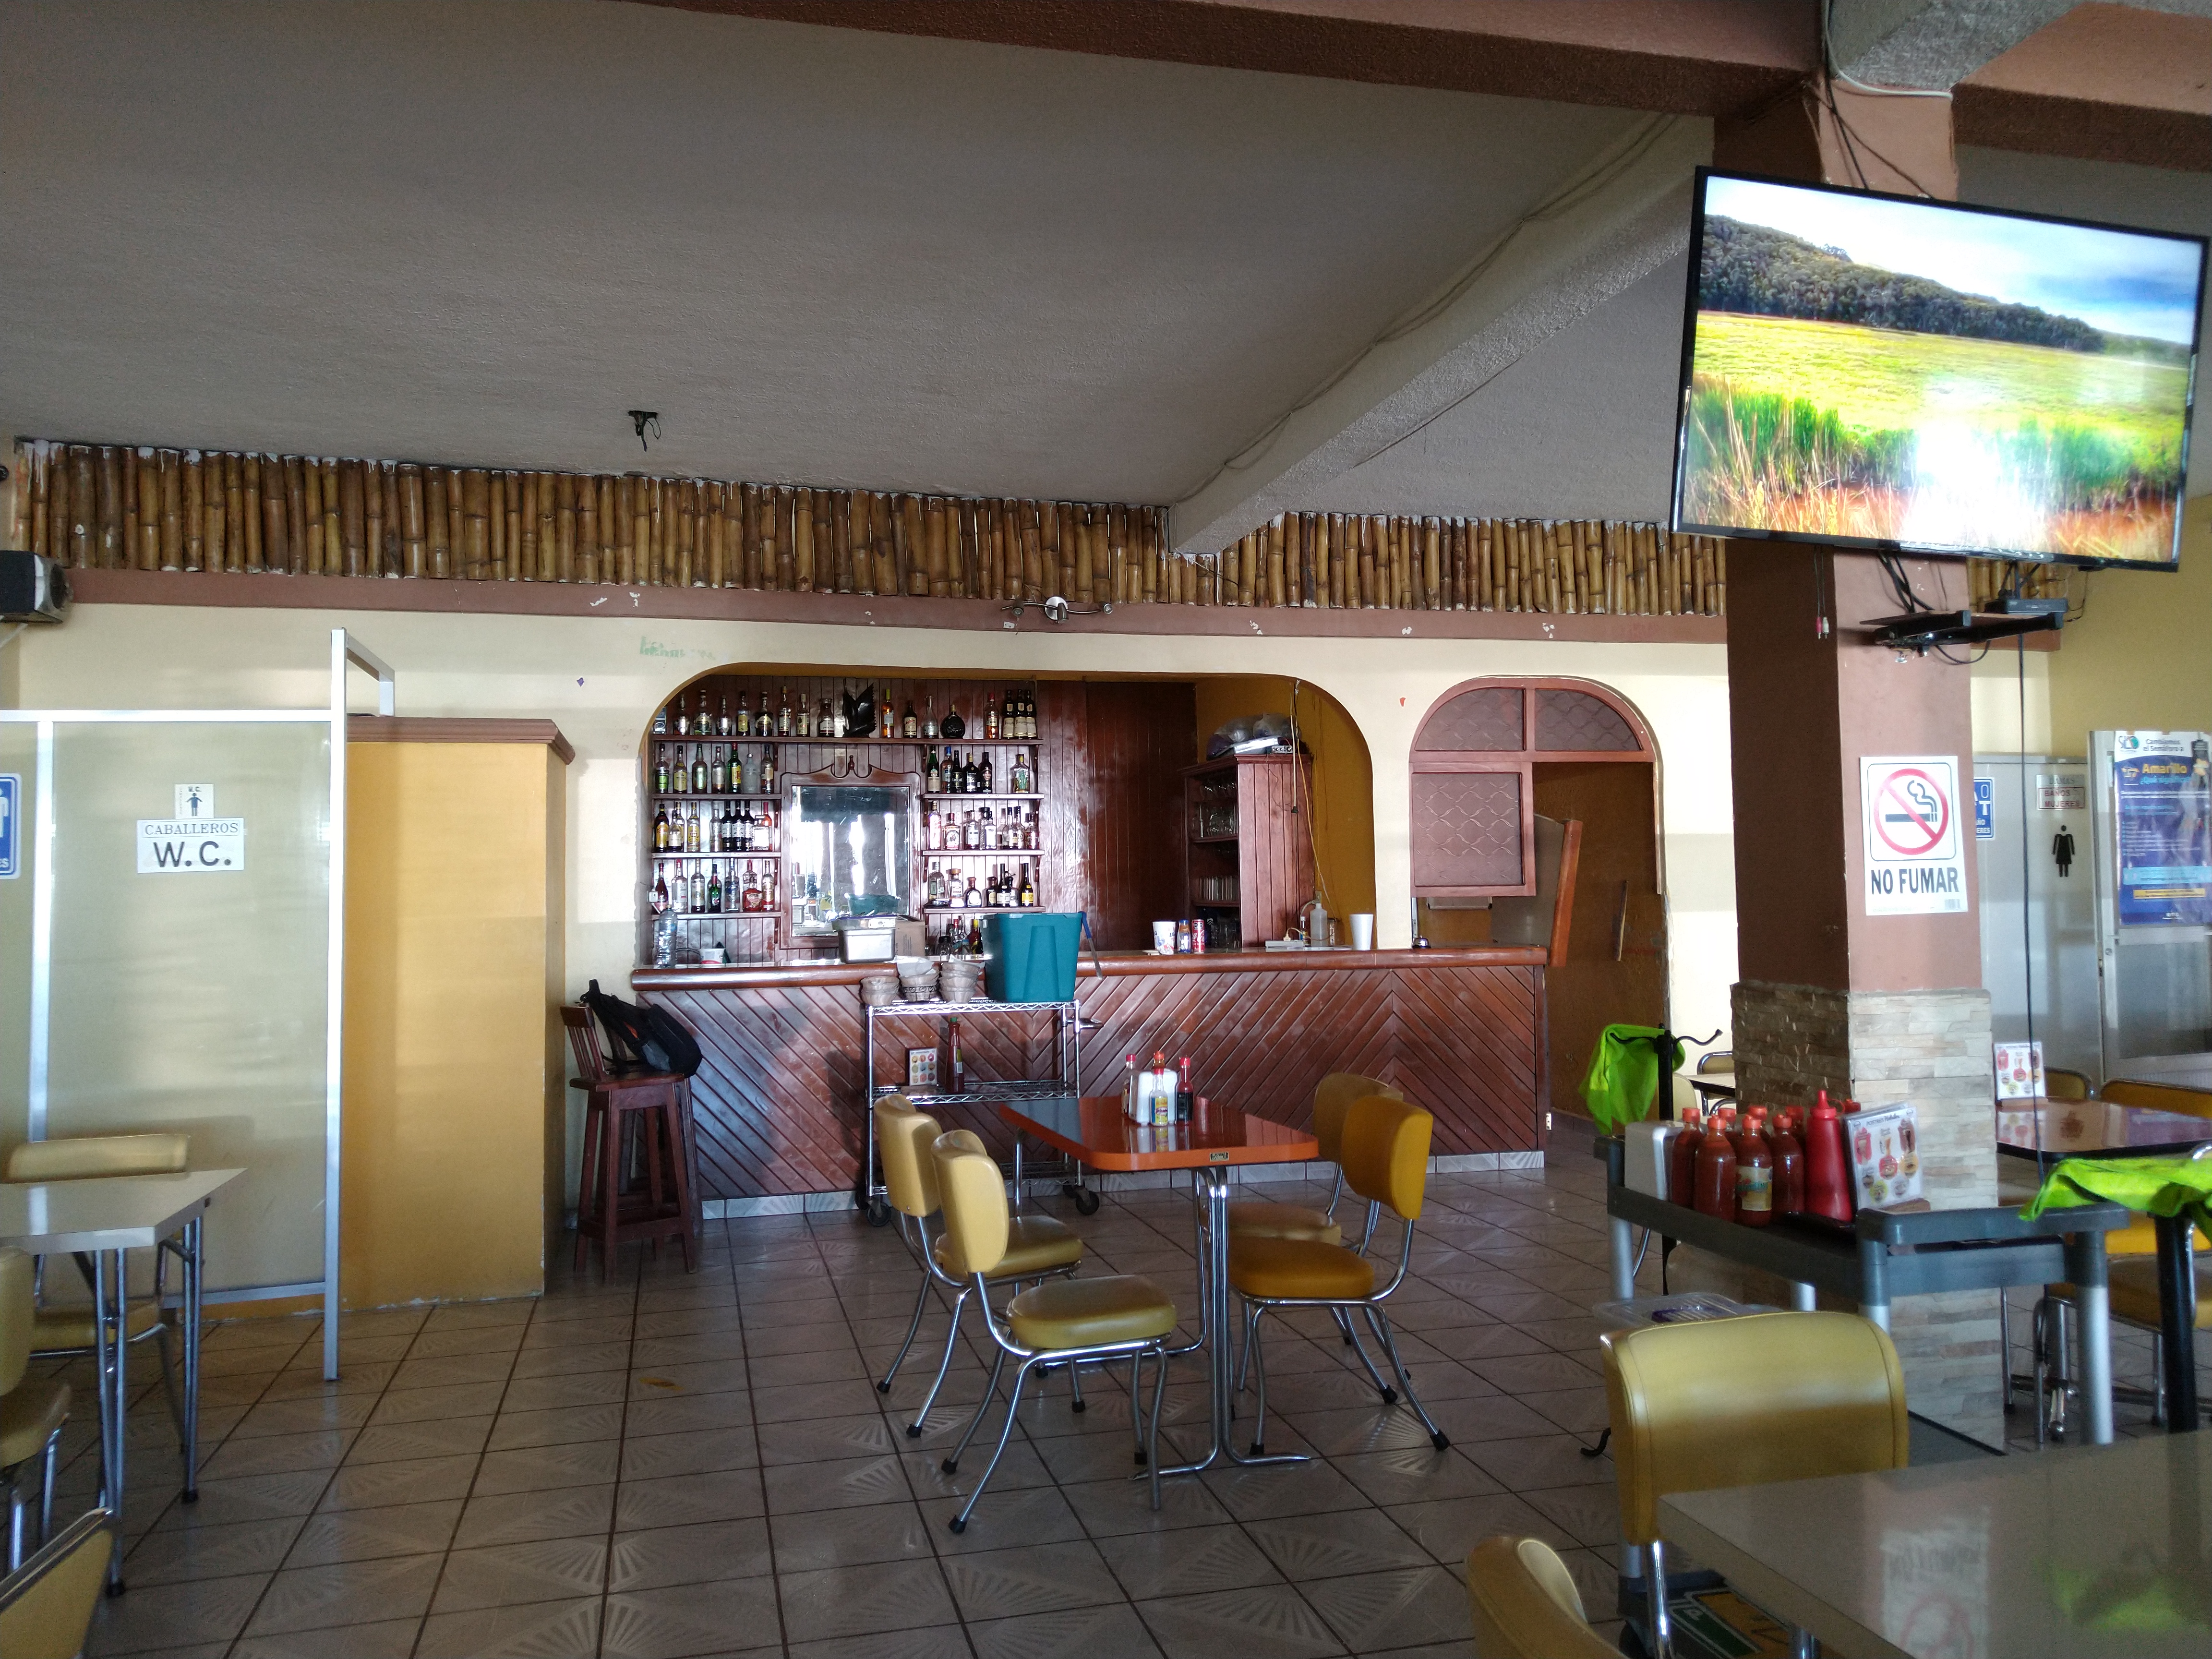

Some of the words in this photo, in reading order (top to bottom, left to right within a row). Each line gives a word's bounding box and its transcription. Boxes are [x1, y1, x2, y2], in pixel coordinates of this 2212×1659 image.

[2142, 763, 2188, 774] Amarillo
[145, 823, 239, 835] CABALLEROS
[152, 840, 232, 868] W.C.
[1871, 869, 1893, 895] NO
[1899, 867, 1960, 894] FUMAR
